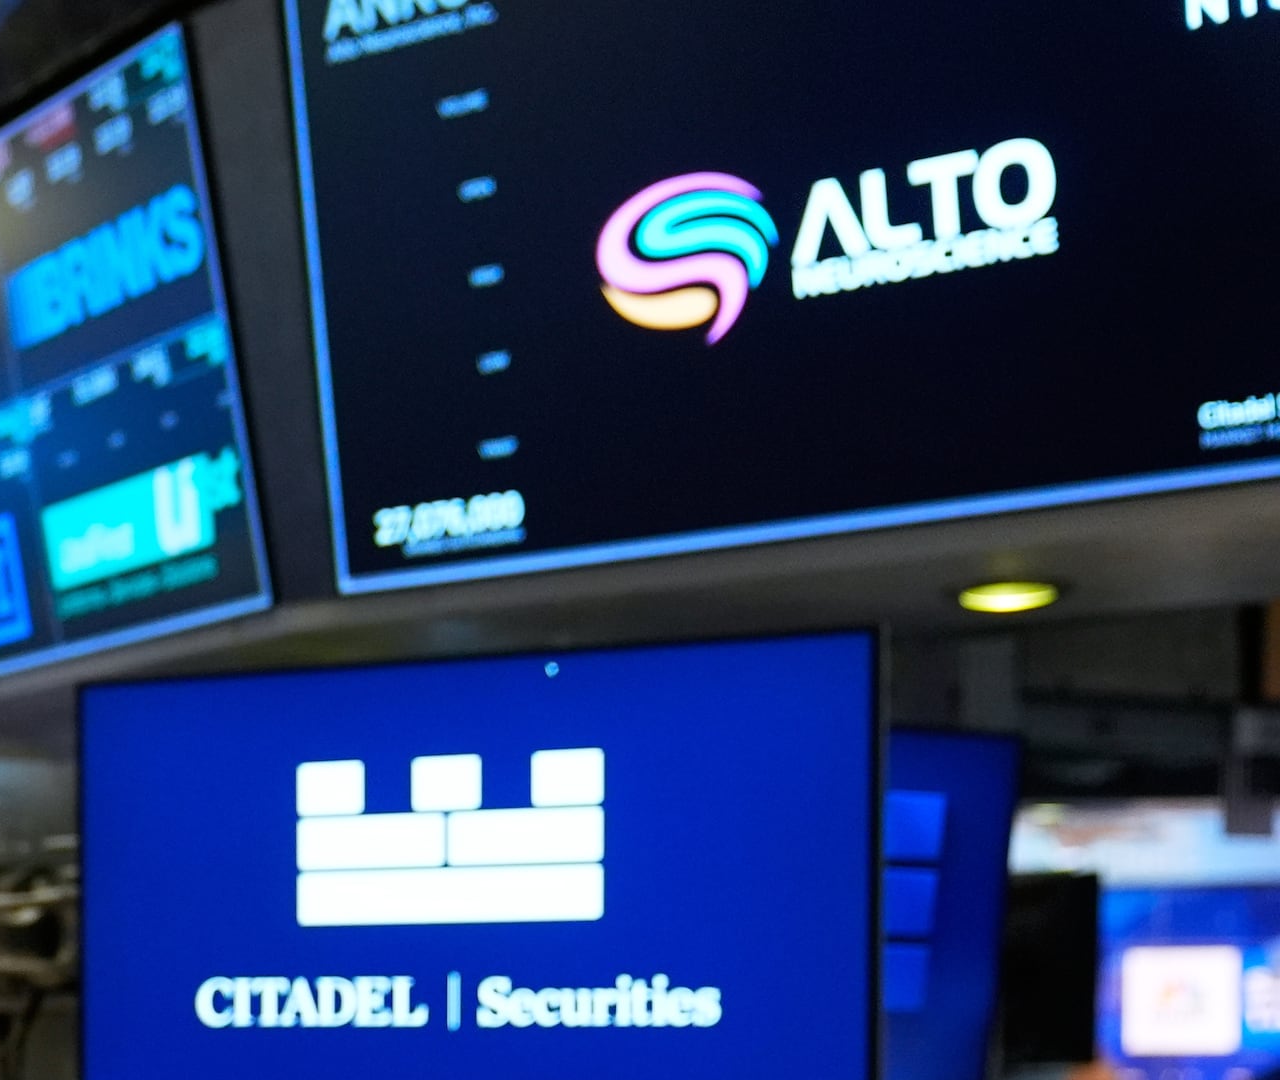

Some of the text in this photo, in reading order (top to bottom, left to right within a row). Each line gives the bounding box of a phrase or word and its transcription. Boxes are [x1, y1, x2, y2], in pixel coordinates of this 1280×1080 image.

[791, 137, 1057, 266] ALTO
[195, 973, 722, 1028] CITADEL Securities
